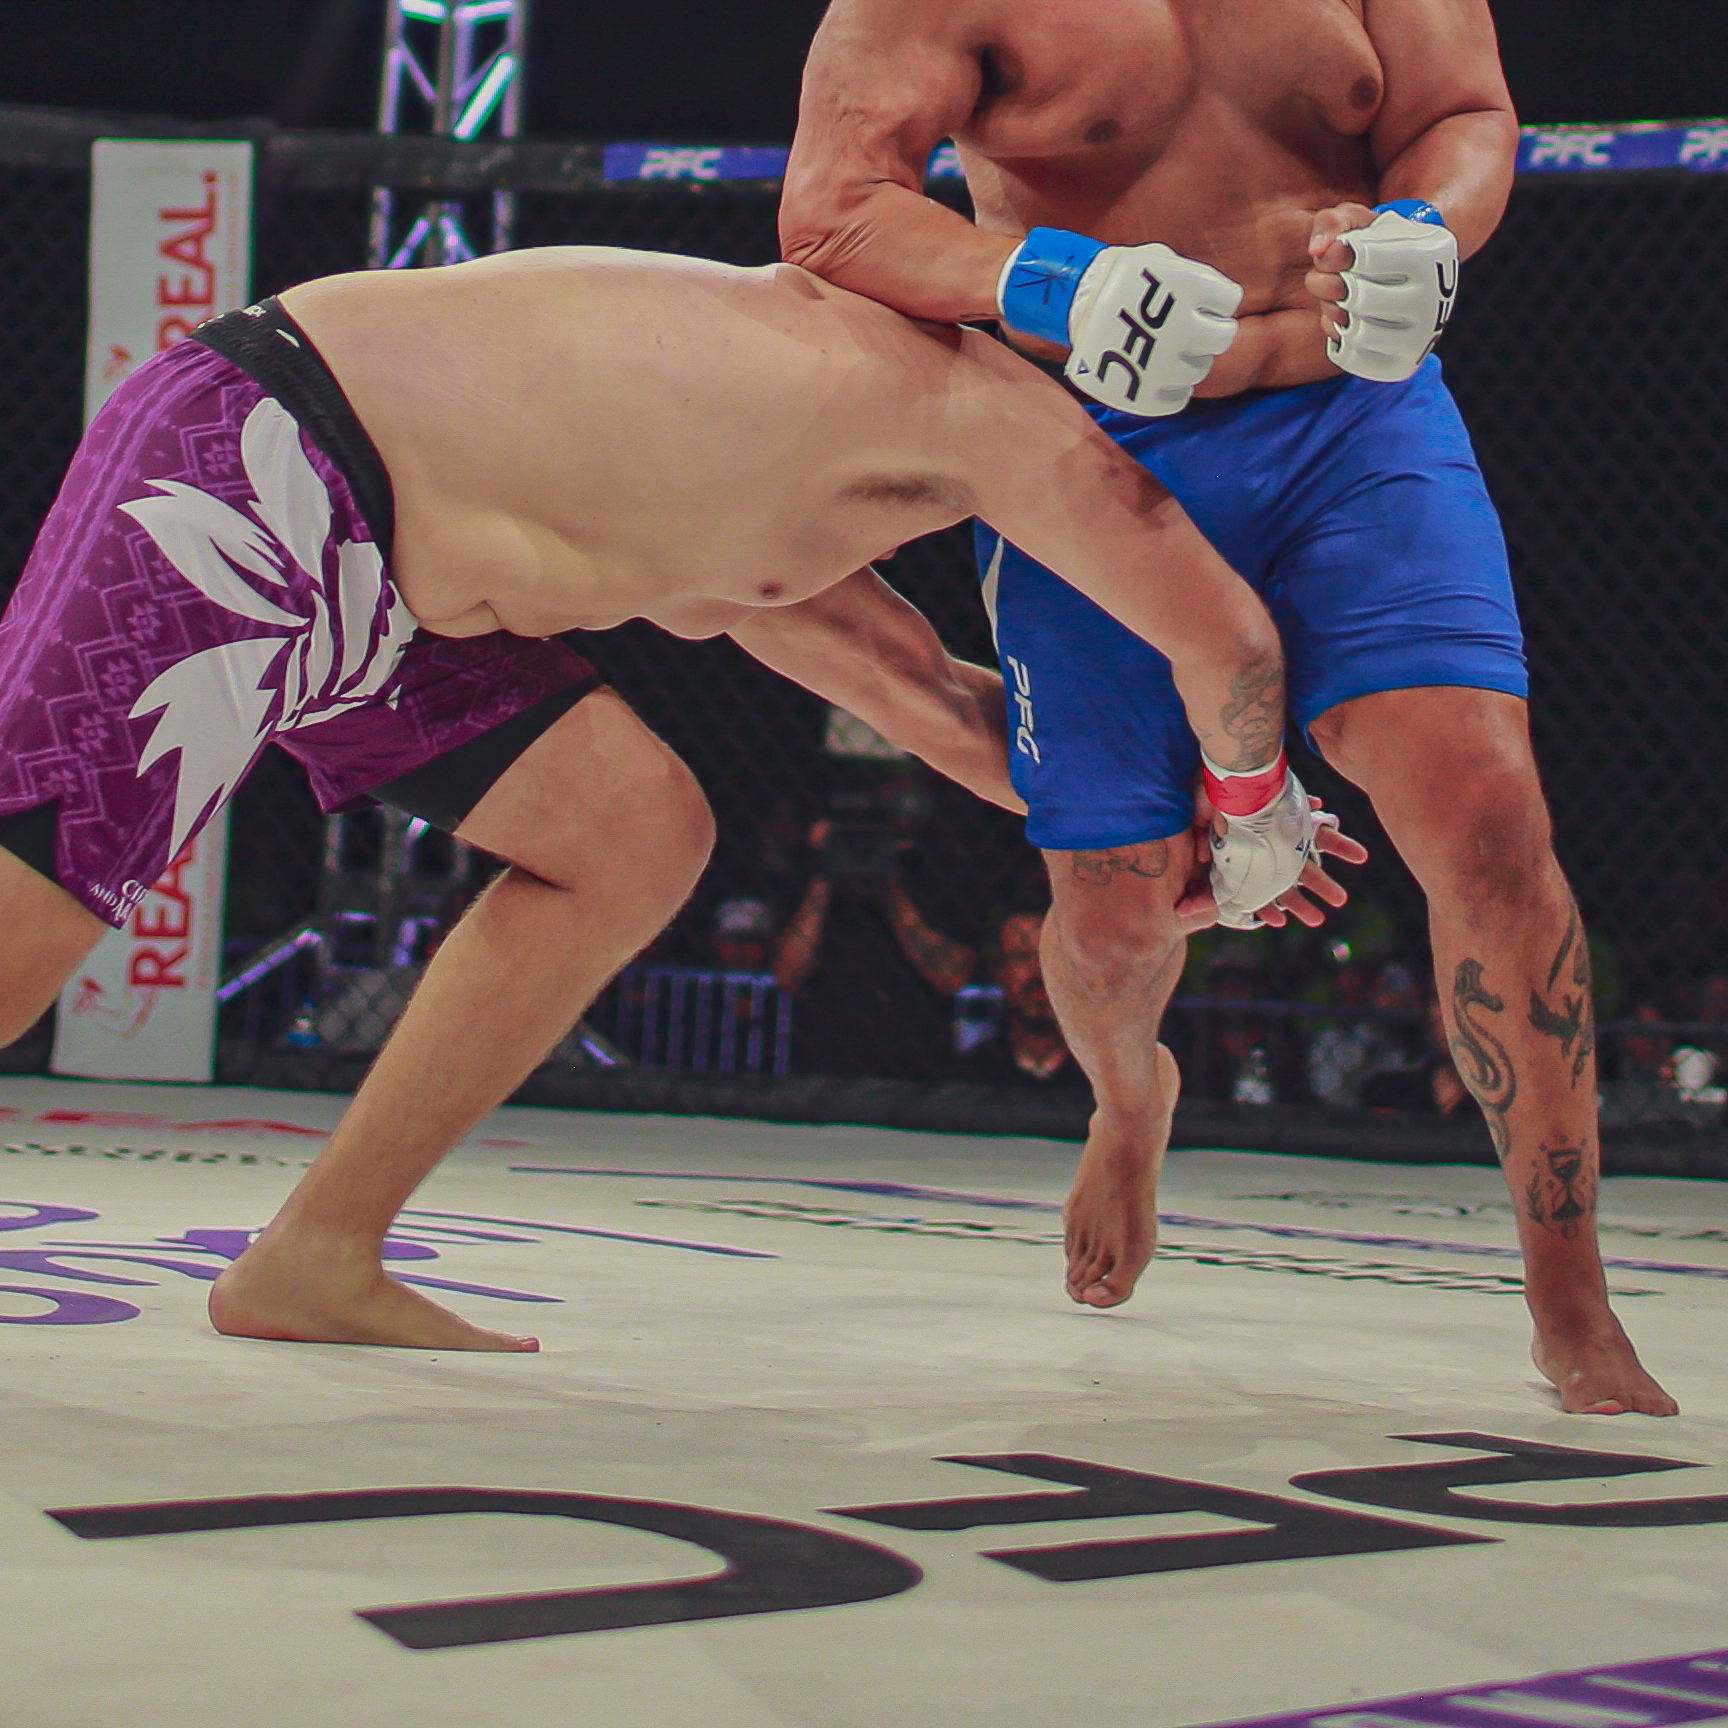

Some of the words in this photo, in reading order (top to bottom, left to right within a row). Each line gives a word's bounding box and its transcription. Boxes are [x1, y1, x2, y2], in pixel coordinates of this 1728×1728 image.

[640, 147, 724, 179] PFC
[1530, 131, 1615, 166] PFC
[1093, 266, 1176, 403] PFC
[1006, 654, 1041, 766] PFC
